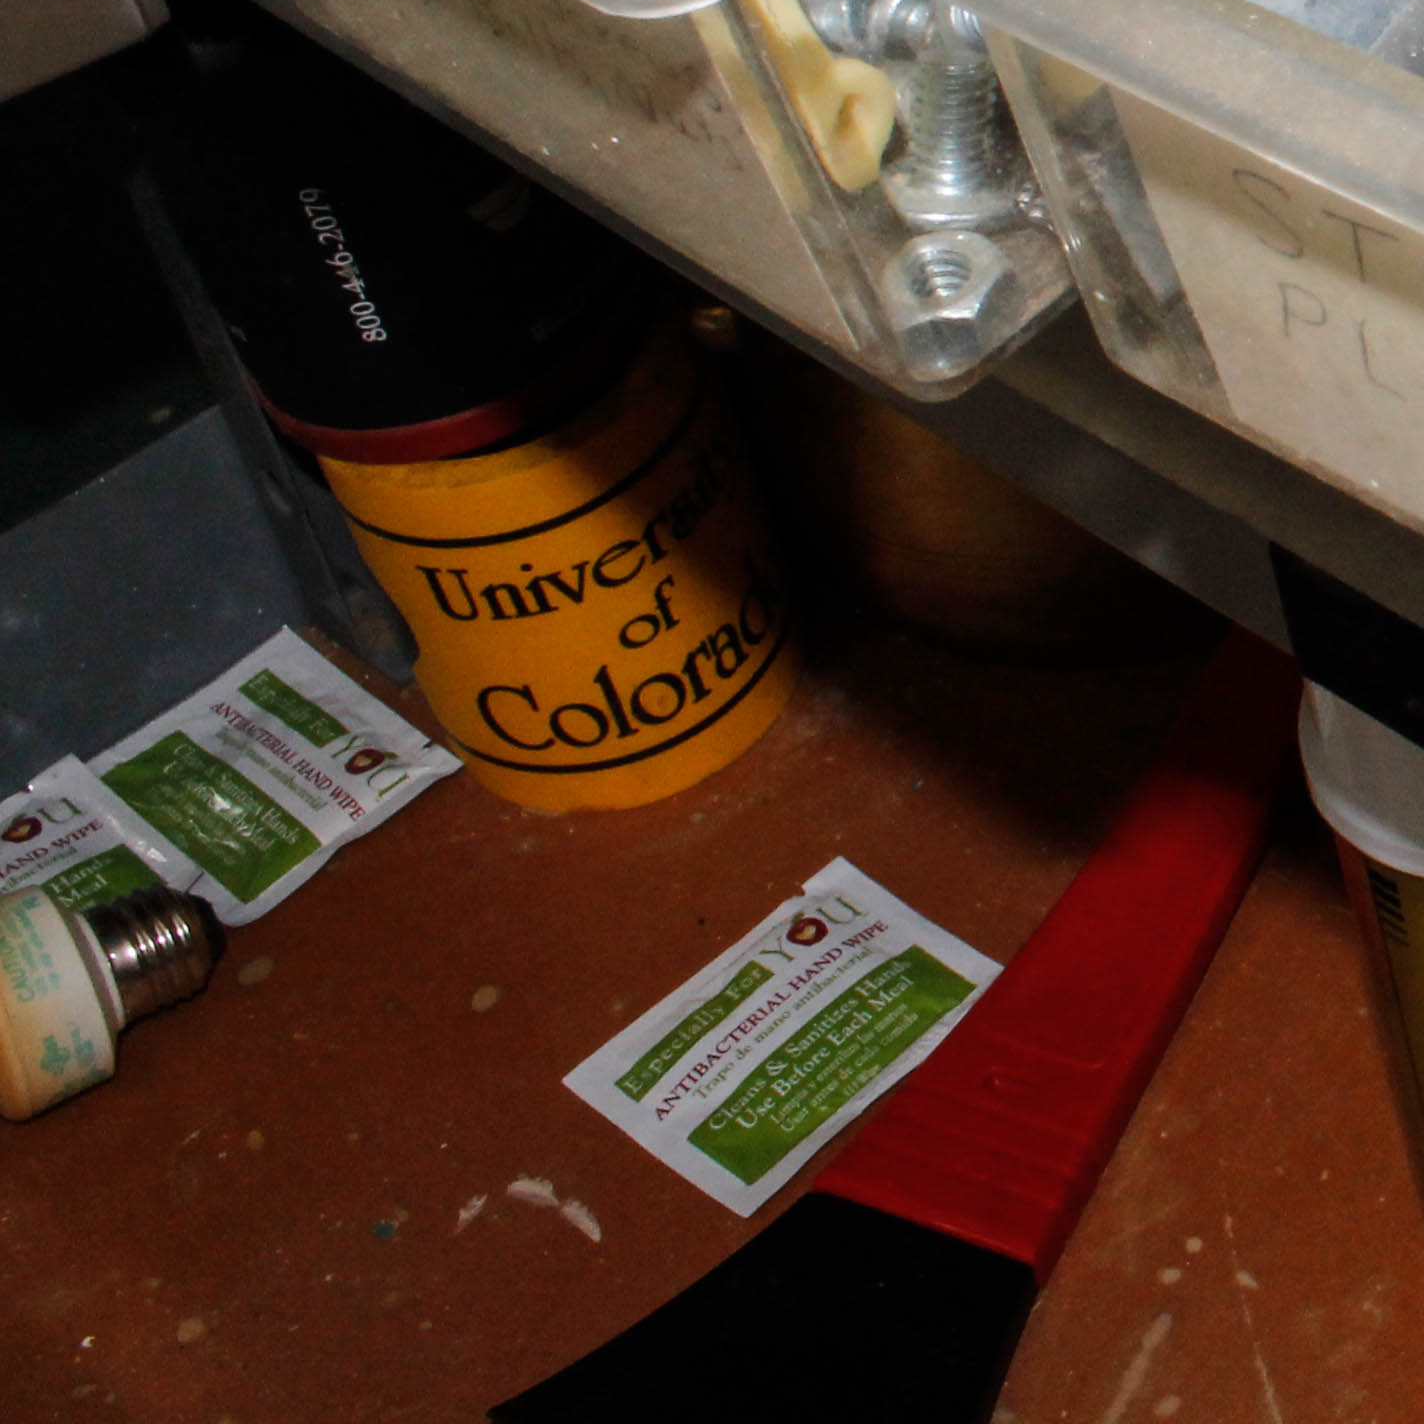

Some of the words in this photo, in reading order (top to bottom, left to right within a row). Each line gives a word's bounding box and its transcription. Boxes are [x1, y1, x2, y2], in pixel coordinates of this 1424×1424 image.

[618, 574, 680, 649] of
[293, 758, 333, 792] HAND
[329, 784, 368, 822] WIPE
[51, 816, 104, 848] WIPE
[724, 969, 763, 1000] For
[655, 990, 792, 1122] ANTIBACTERIAL
[788, 946, 844, 992] HAND
[841, 920, 889, 949] WIPE
[736, 1095, 777, 1129] Use
[769, 1044, 832, 1097] Before
[826, 1008, 874, 1047] Each
[867, 974, 915, 1013] Meal
